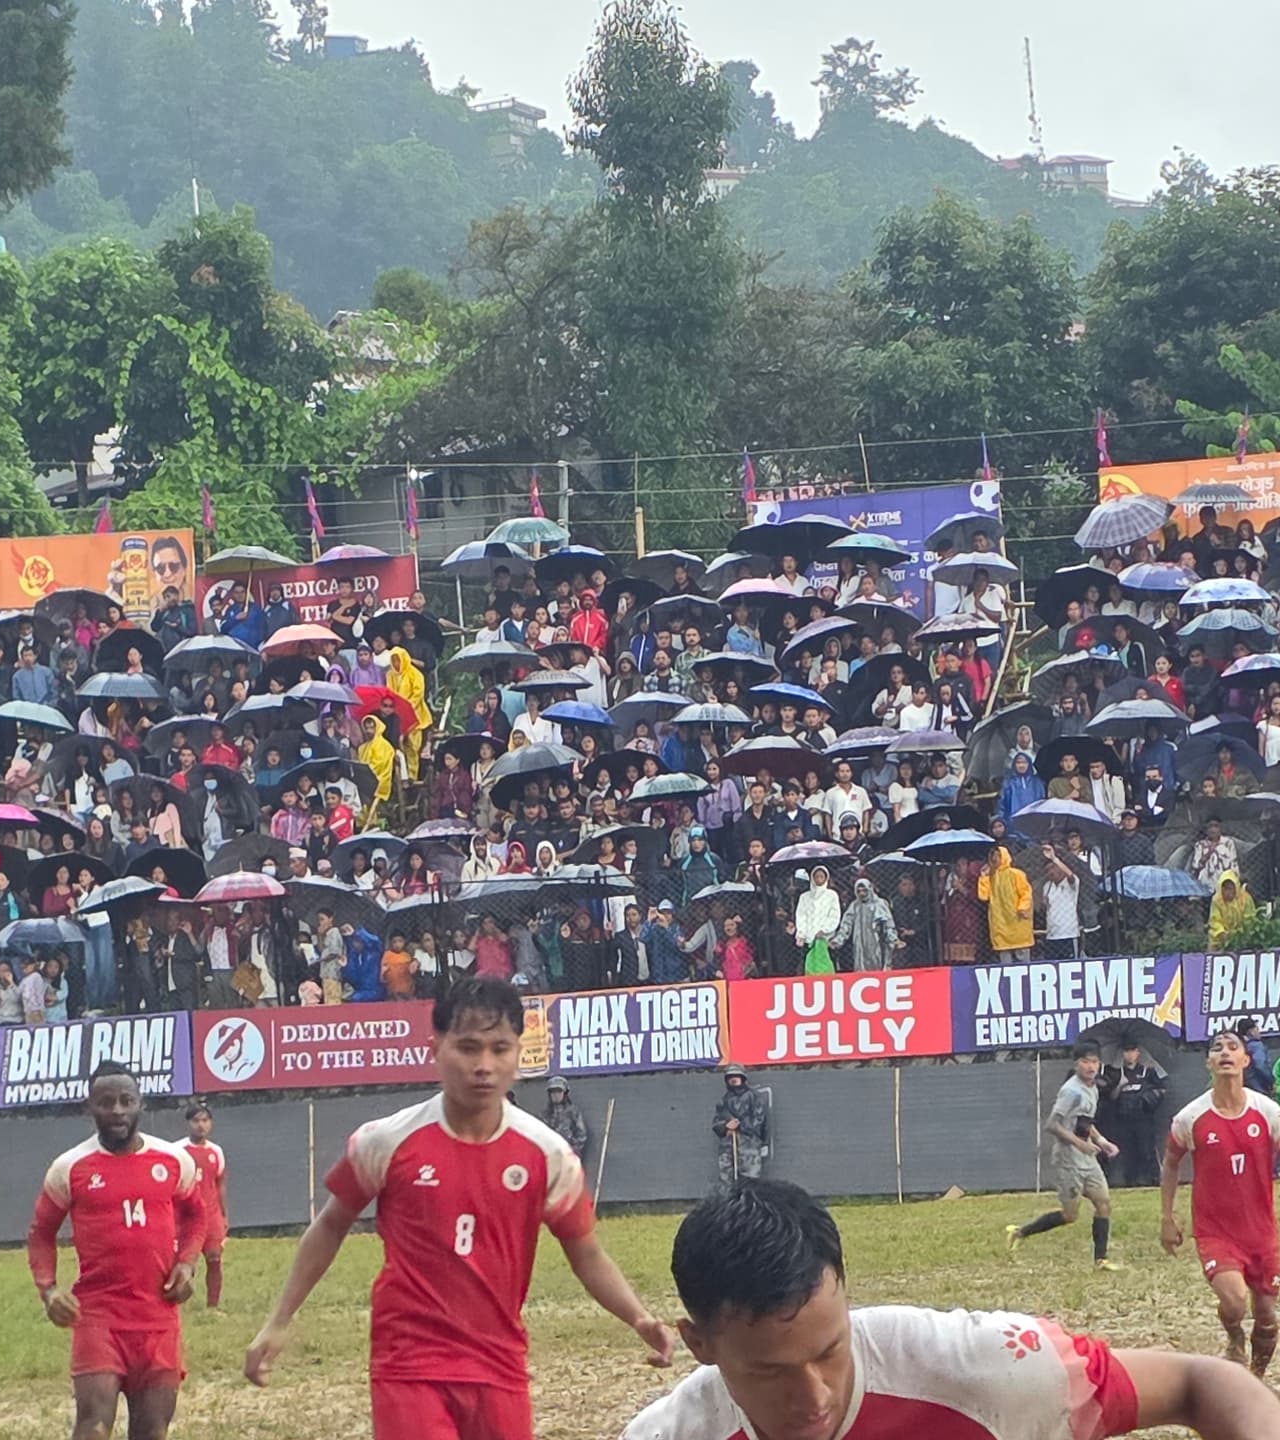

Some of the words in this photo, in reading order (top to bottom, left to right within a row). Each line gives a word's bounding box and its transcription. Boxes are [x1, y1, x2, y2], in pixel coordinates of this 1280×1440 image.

[766, 976, 913, 1019] JUICE
[975, 957, 1156, 1015] XTREME
[281, 1020, 411, 1043] DEDICATED
[559, 994, 629, 1037] MAX
[636, 987, 718, 1031] TIGER
[975, 1013, 1070, 1046] ENERGY
[8, 1024, 83, 1082] BAM
[281, 1052, 312, 1071] TO
[317, 1050, 365, 1069] THE
[371, 1047, 435, 1066] BRAV
[559, 1034, 645, 1068] ENERGY
[651, 1027, 720, 1062] DRINK
[767, 1017, 916, 1060] JELLY
[1230, 1153, 1245, 1175] 17
[123, 1198, 146, 1228] 14
[454, 1214, 475, 1256] 8
